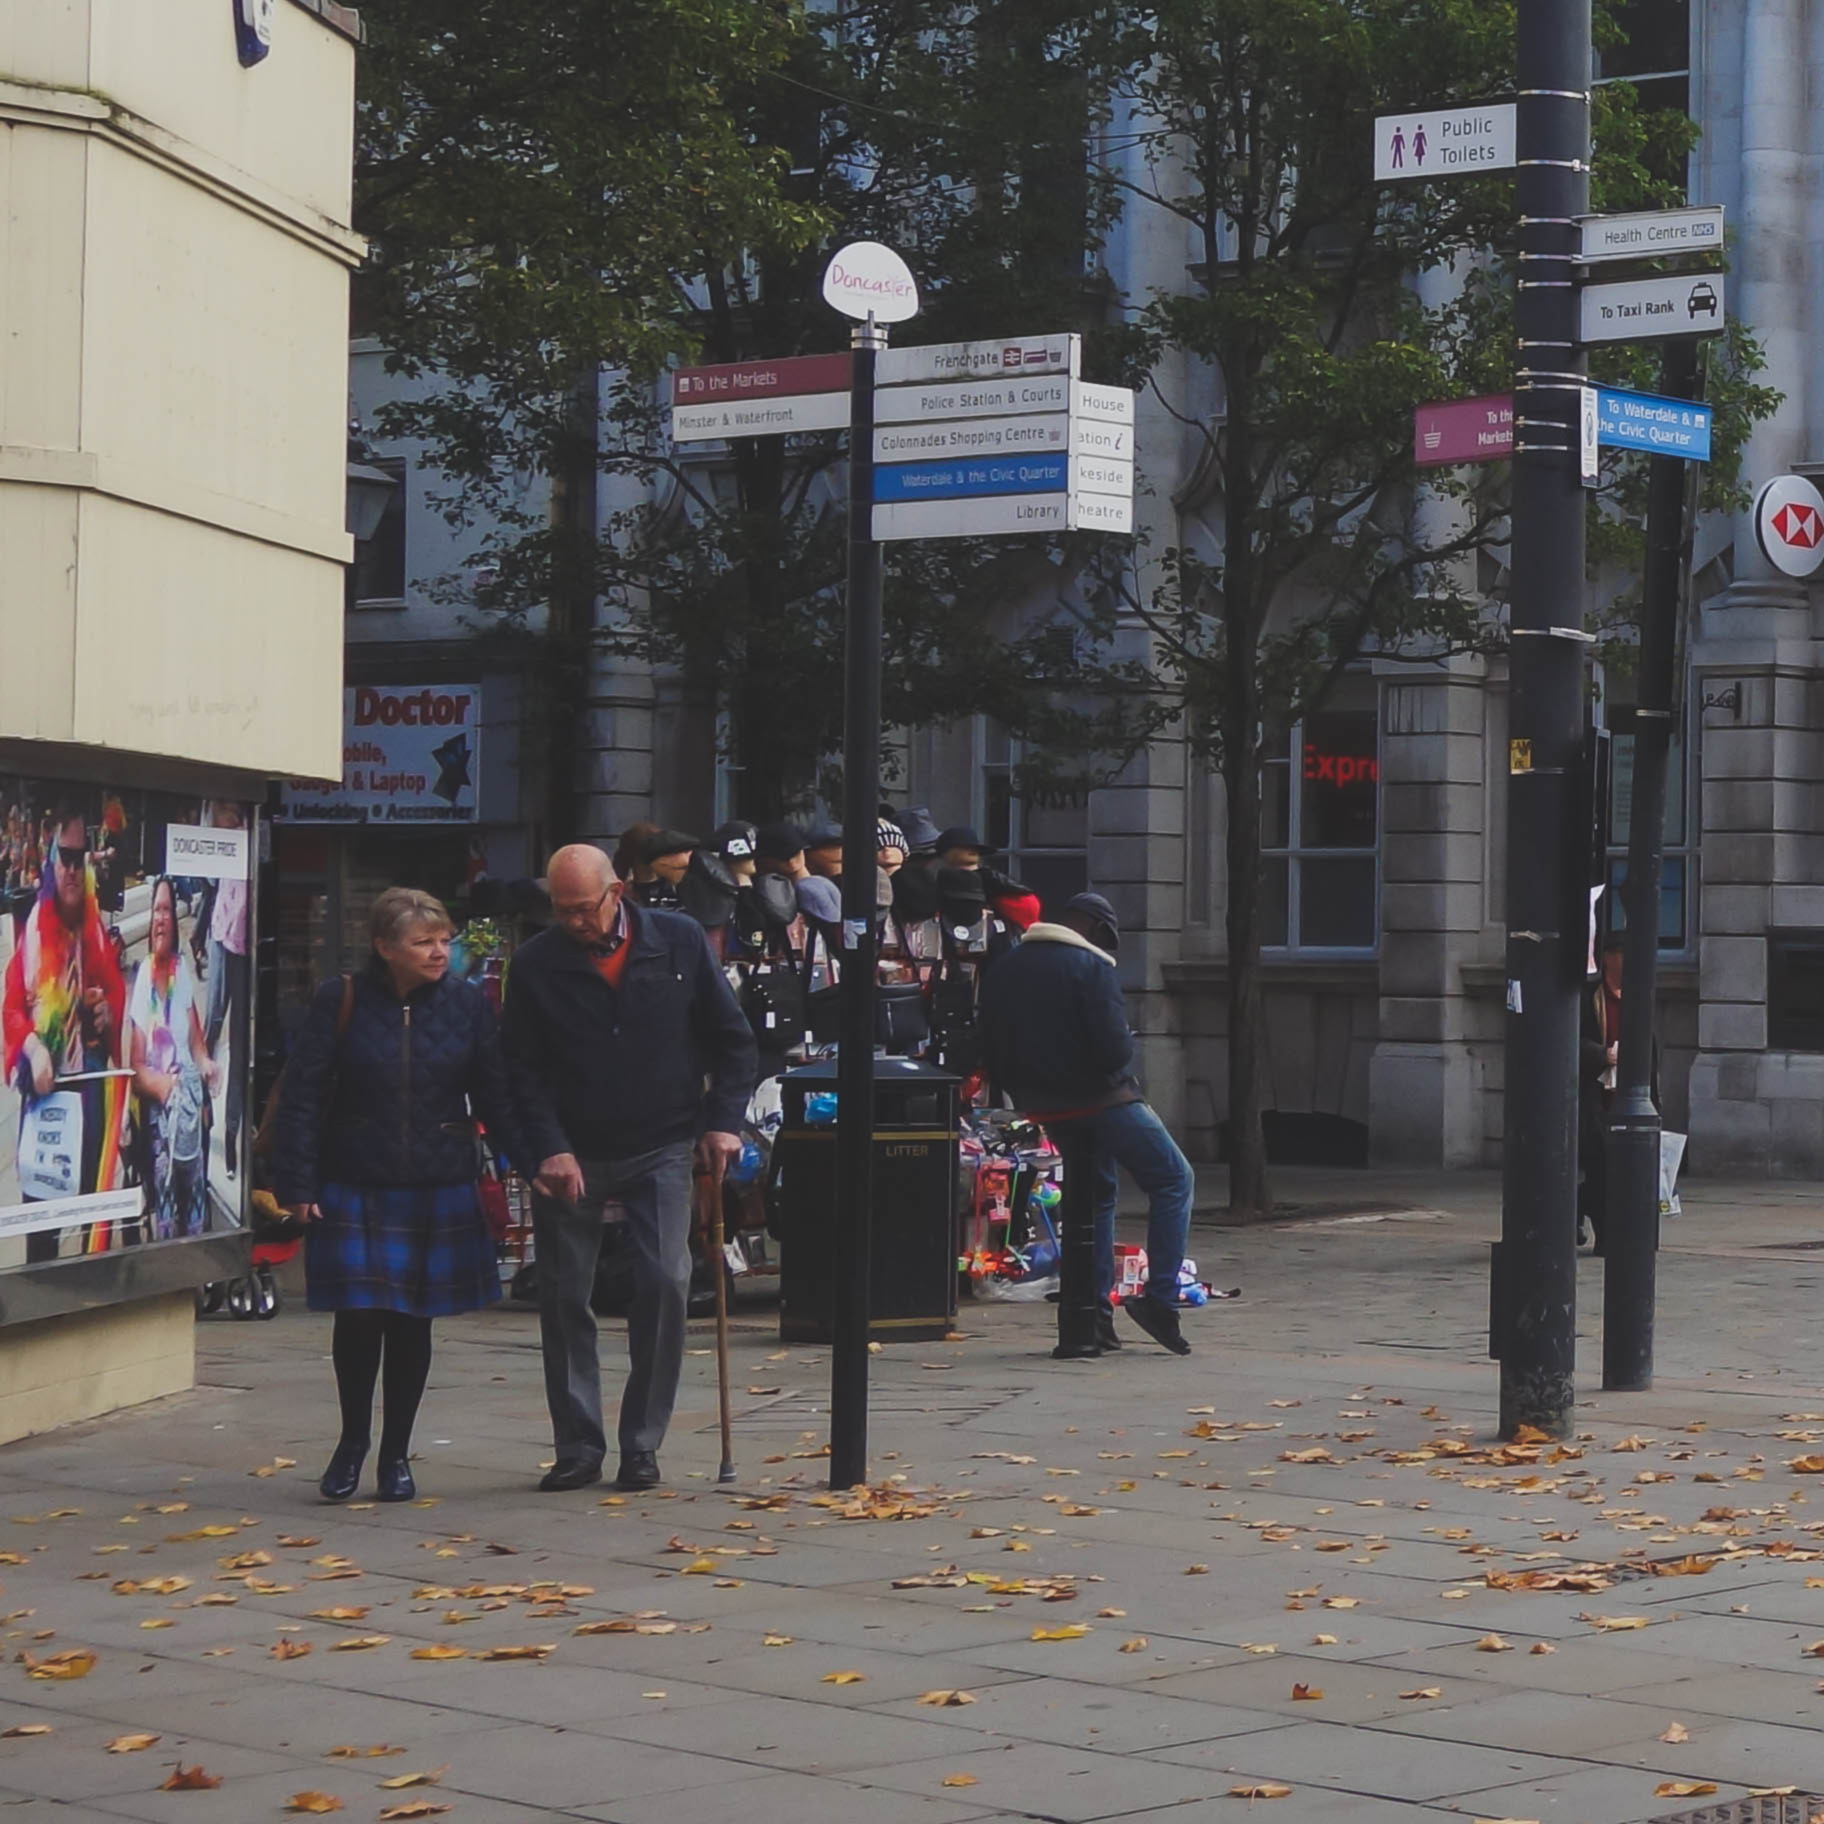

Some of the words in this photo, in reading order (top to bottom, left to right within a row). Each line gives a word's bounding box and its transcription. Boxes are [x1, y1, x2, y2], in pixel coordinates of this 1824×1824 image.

[1442, 118, 1493, 137] Public
[1440, 146, 1495, 164] Toilets
[1605, 228, 1642, 245] Health
[1648, 226, 1687, 241] Centre
[1692, 224, 1714, 236] NHS
[833, 264, 912, 297] Doncaster
[1601, 306, 1613, 319] To
[1617, 302, 1641, 317] Taxi
[1646, 300, 1674, 315] Rank
[934, 352, 998, 368] Frenchgate
[692, 377, 705, 391] To
[710, 375, 728, 390] the
[733, 371, 777, 388] Markets
[921, 396, 954, 410] Police
[960, 392, 1001, 407] Station
[1008, 391, 1016, 403] &
[1022, 388, 1062, 402] Courts
[1083, 395, 1124, 412] House
[680, 415, 717, 429] Minster
[722, 413, 729, 426] &
[735, 408, 794, 424] Waterfront
[1487, 411, 1497, 424] To
[1607, 399, 1619, 414] To
[1624, 403, 1677, 423] Waterdale
[1681, 412, 1690, 425] &
[881, 433, 946, 450] Colonnades
[950, 429, 1001, 445] Shopping
[1005, 427, 1044, 441] Centre
[1619, 421, 1645, 438] Civic
[1650, 427, 1691, 445] Quarter
[902, 472, 952, 487] Waterdale
[956, 470, 964, 483] &
[968, 470, 986, 482] the
[990, 468, 1014, 482] Civic
[1019, 466, 1061, 482] Quarter
[1017, 505, 1060, 519] Library
[354, 687, 471, 726] Doctor
[351, 771, 363, 791] &
[370, 770, 426, 795] Laptop
[886, 1145, 929, 1157] LITTER
